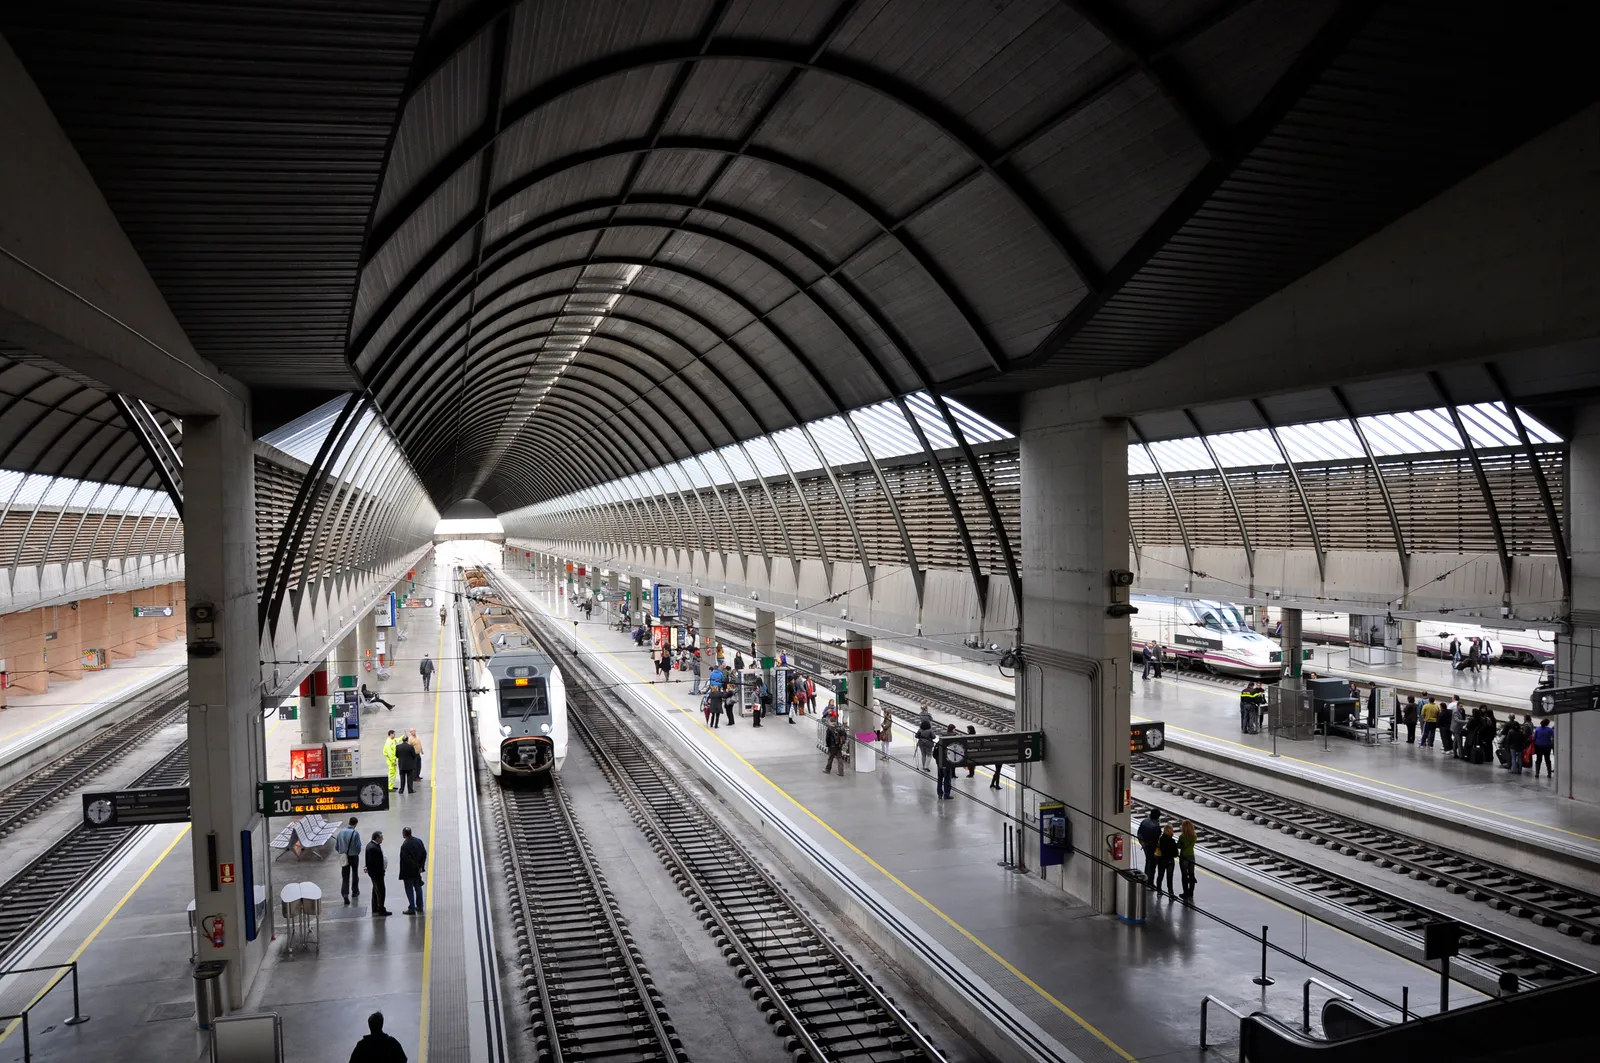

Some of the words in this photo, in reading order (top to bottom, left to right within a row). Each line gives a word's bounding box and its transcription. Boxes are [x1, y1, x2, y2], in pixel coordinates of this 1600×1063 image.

[1284, 667, 1291, 676] A
[1592, 697, 1598, 708] 7
[1024, 748, 1032, 759] 9
[291, 787, 310, 795] 15:35
[315, 796, 335, 804] CADIZ
[274, 799, 291, 813] 10
[295, 805, 304, 813] DE
[305, 804, 315, 812] LA
